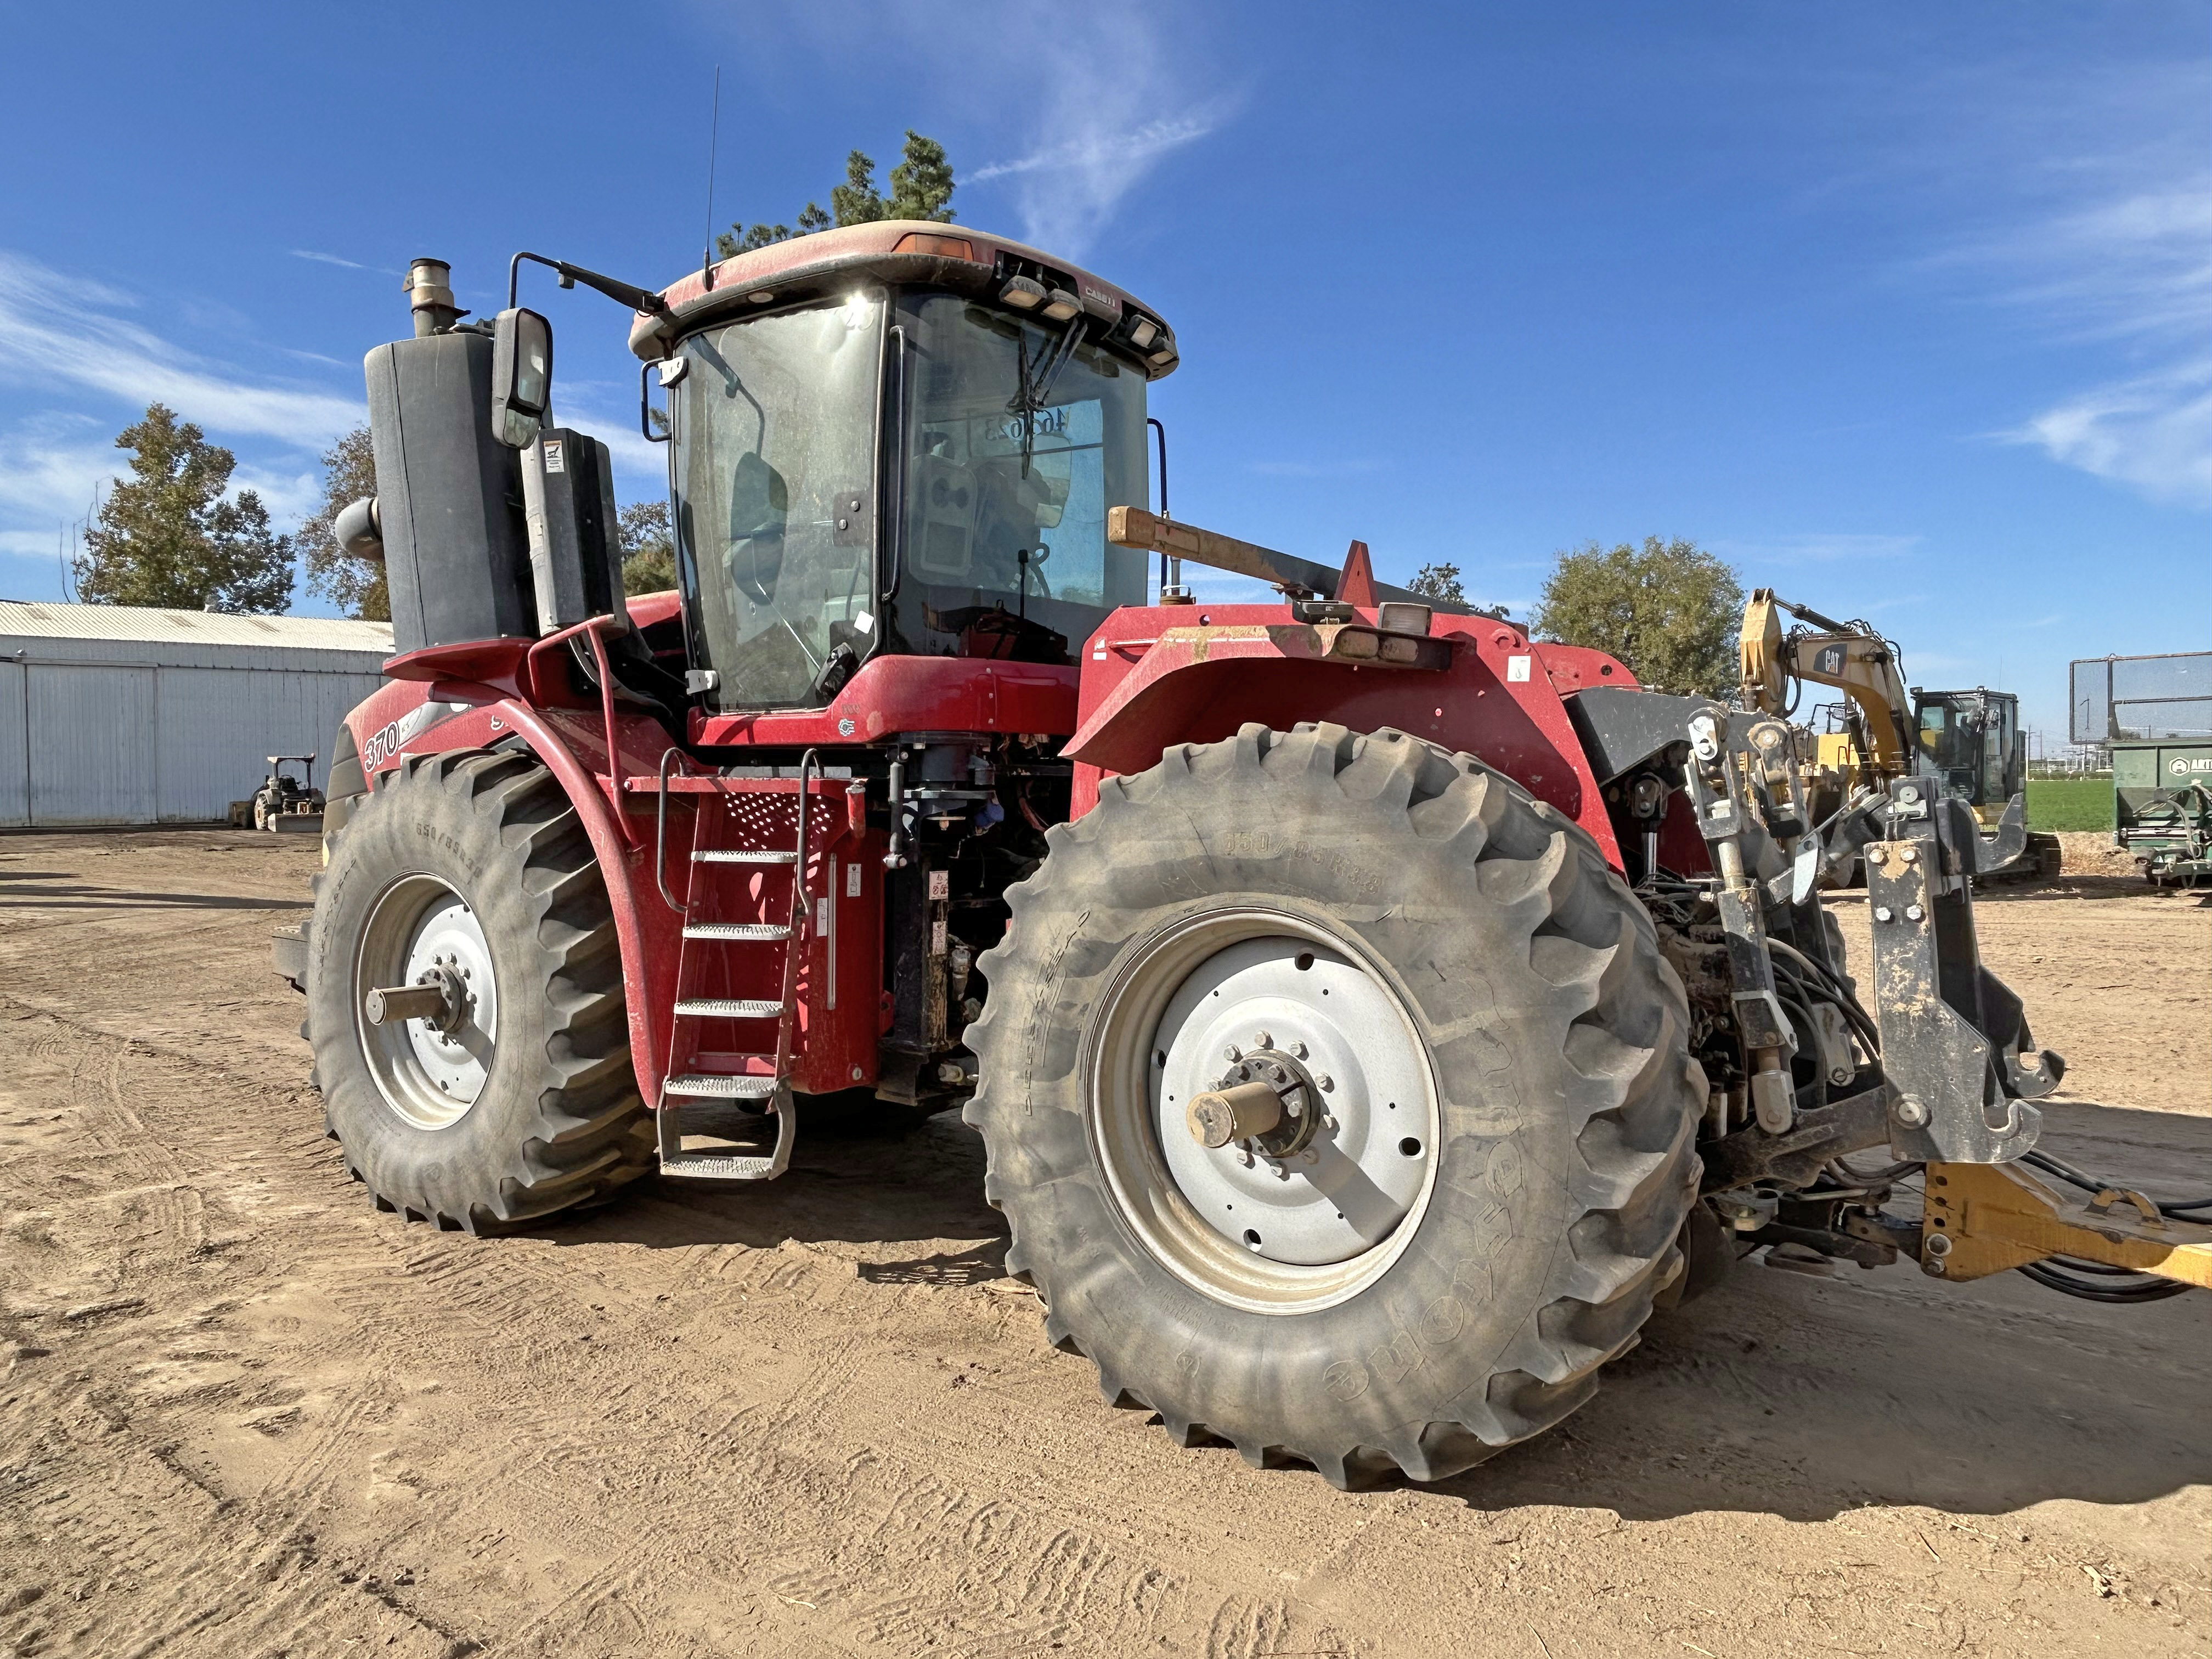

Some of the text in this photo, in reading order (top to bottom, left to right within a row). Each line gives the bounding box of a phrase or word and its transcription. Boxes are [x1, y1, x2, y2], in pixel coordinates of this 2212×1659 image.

[1825, 650, 1839, 674] CAT
[364, 721, 399, 772] 370
[2191, 759, 2212, 769] ART
